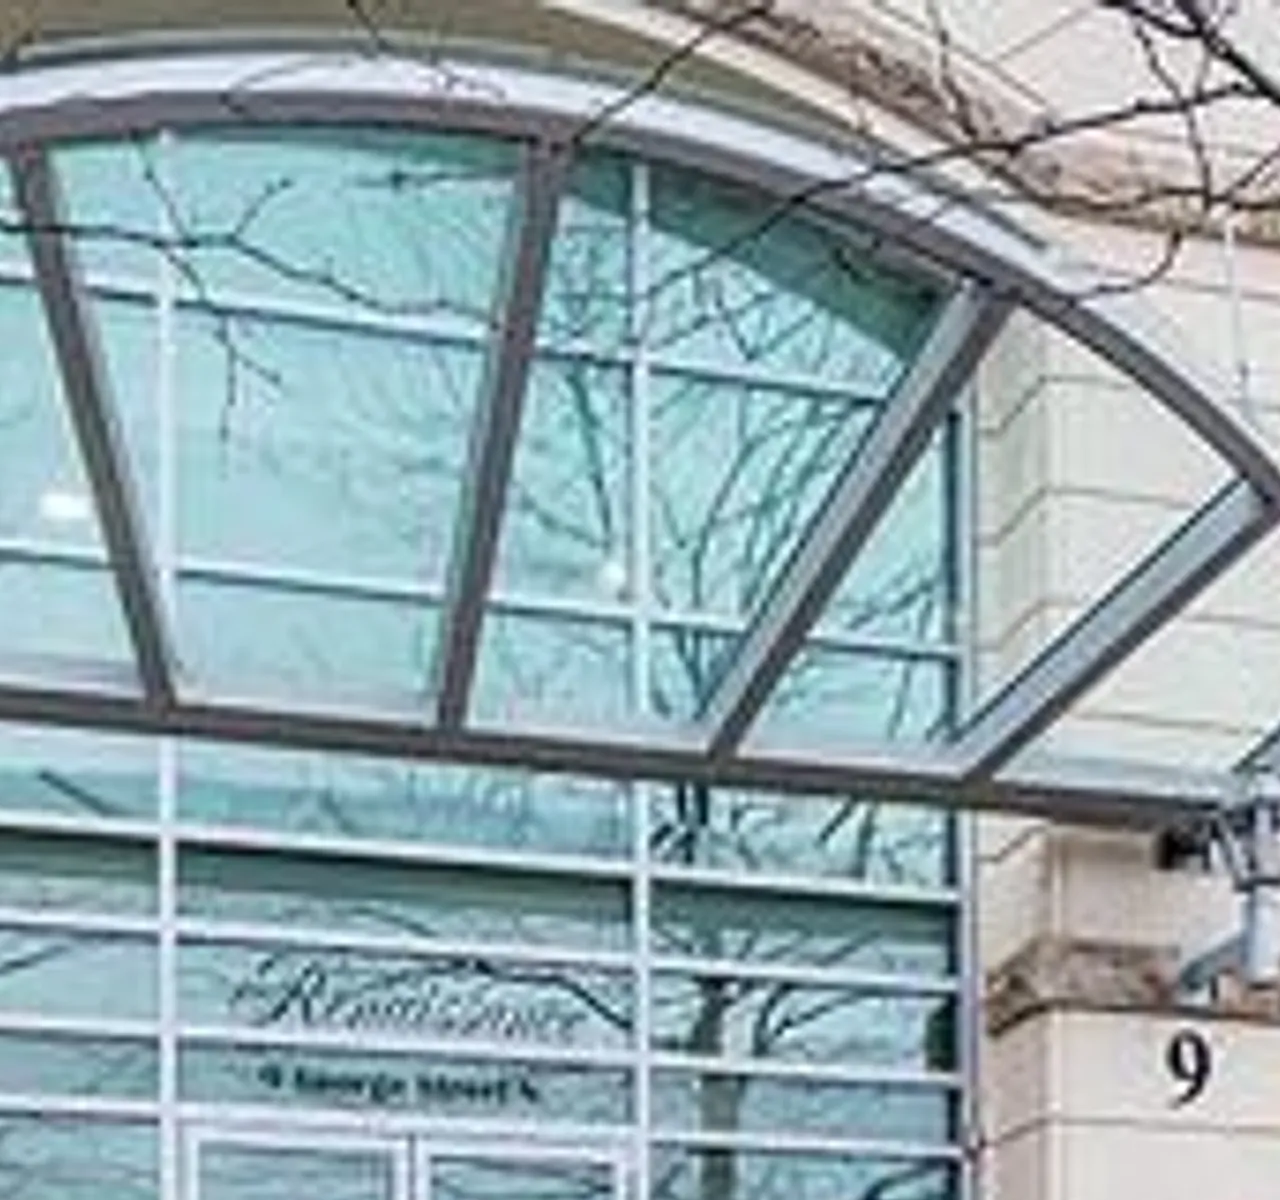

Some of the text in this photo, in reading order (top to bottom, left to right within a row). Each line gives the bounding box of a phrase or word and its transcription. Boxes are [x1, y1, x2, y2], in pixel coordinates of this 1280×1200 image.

[294, 1064, 408, 1103] George
[414, 1072, 510, 1104] Street
[1165, 1028, 1212, 1111] 9
